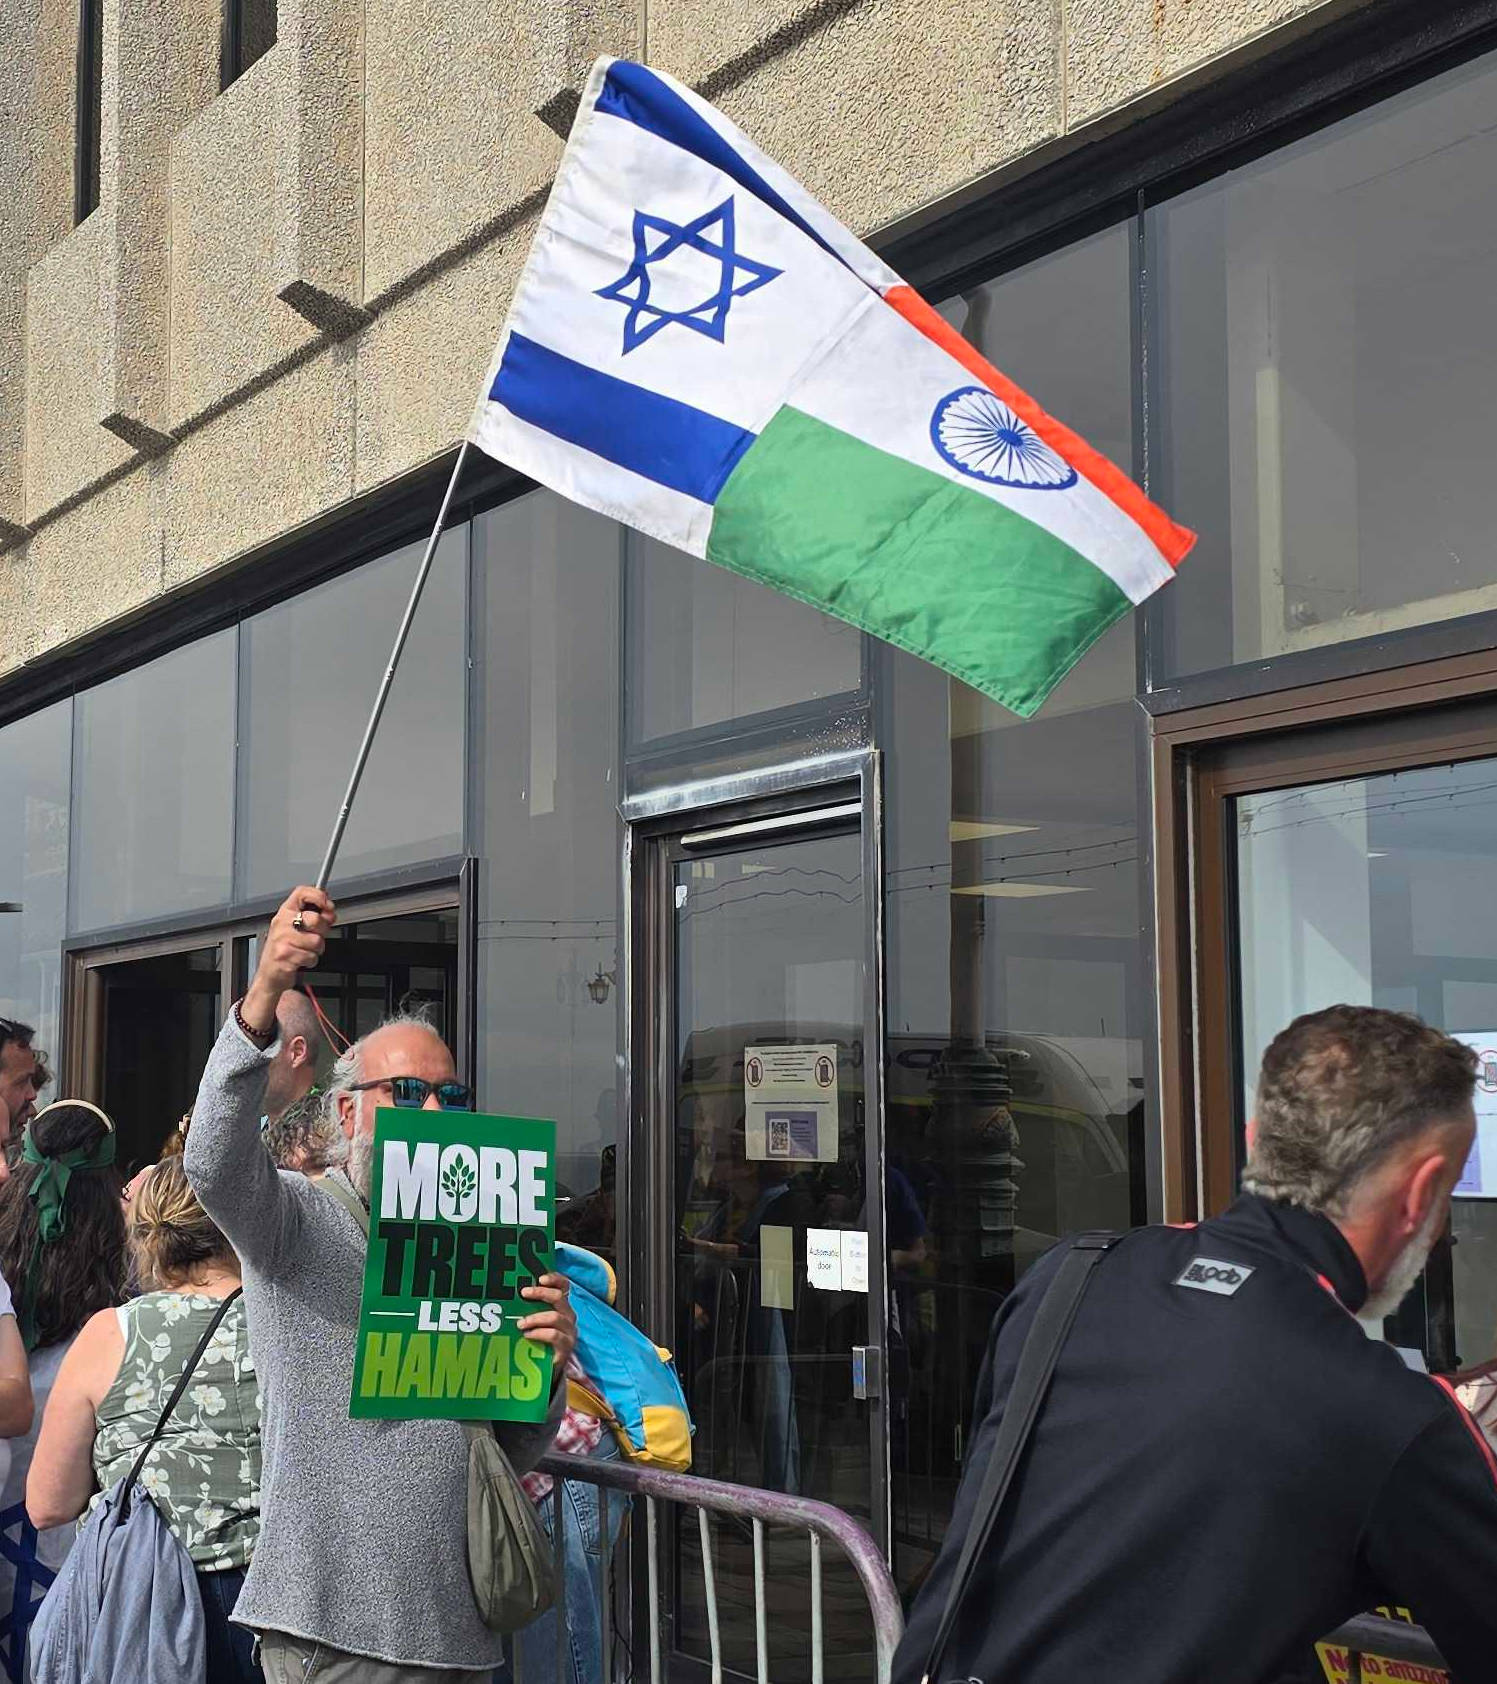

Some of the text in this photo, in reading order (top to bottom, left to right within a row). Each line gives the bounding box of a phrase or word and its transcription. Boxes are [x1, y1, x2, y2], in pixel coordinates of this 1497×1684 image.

[380, 1140, 548, 1227] MORE
[378, 1221, 550, 1301] TREES
[417, 1300, 503, 1334] LESS
[359, 1331, 547, 1401] HAMAS
